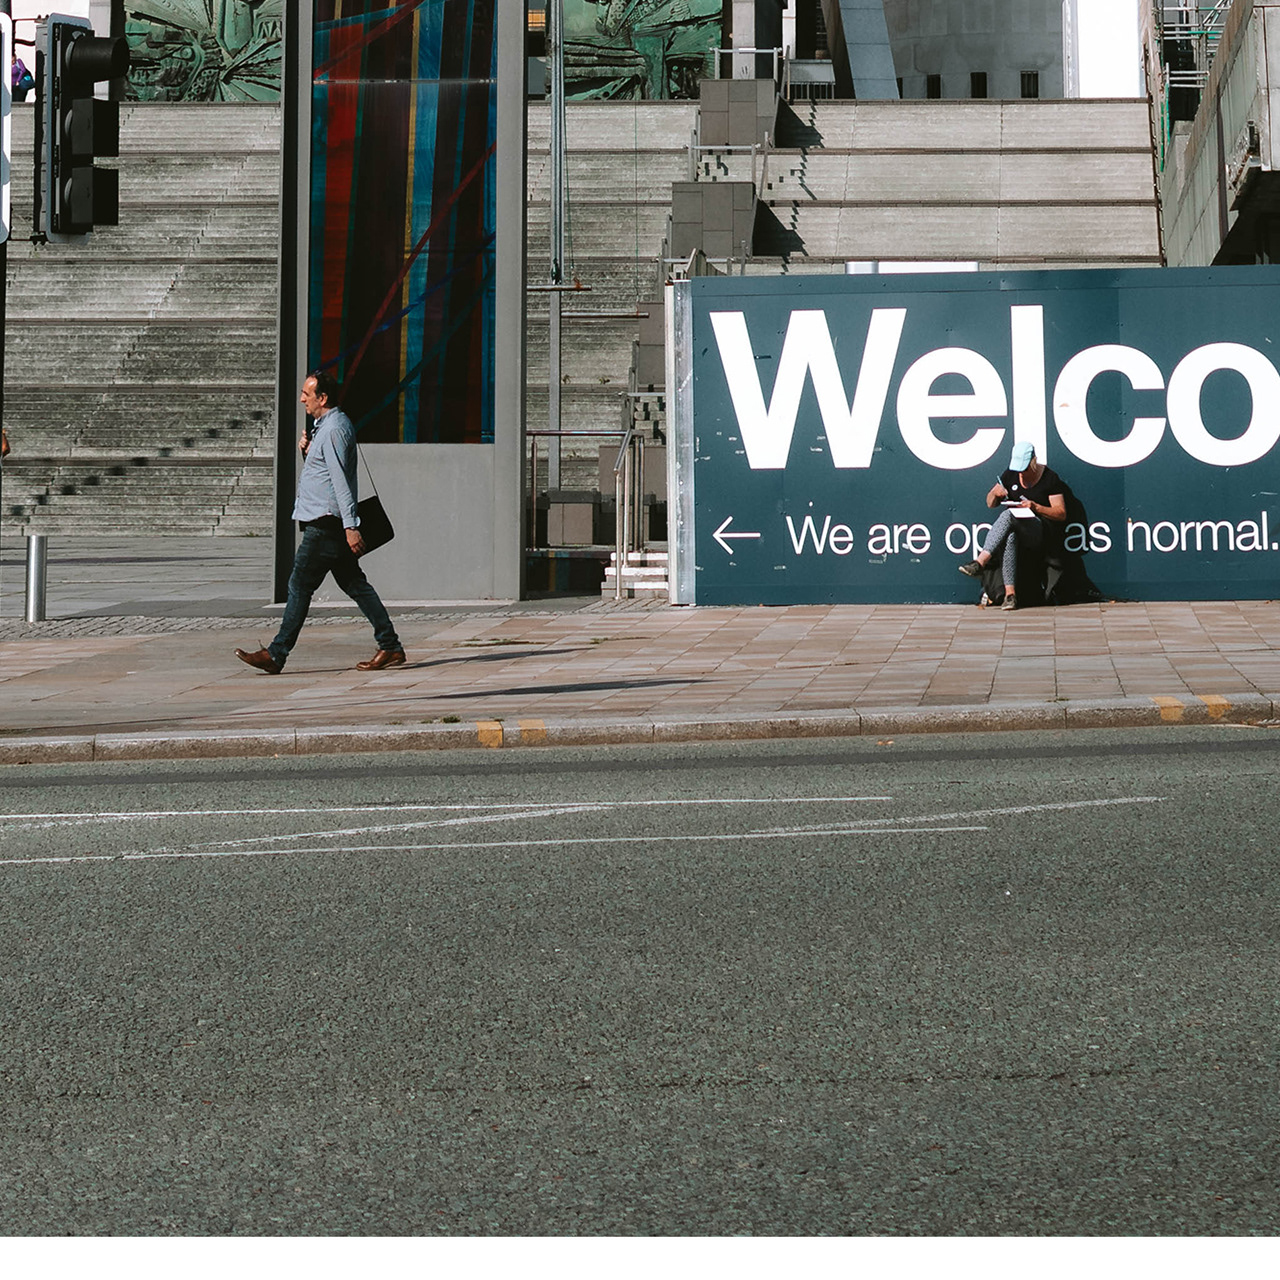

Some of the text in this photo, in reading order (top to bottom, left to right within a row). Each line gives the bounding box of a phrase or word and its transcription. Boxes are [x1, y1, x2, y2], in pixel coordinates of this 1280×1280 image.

[785, 515, 854, 555] We
[867, 523, 931, 555] are
[944, 522, 993, 561] op
[1063, 521, 1112, 553] as
[1127, 510, 1279, 552] normal.
